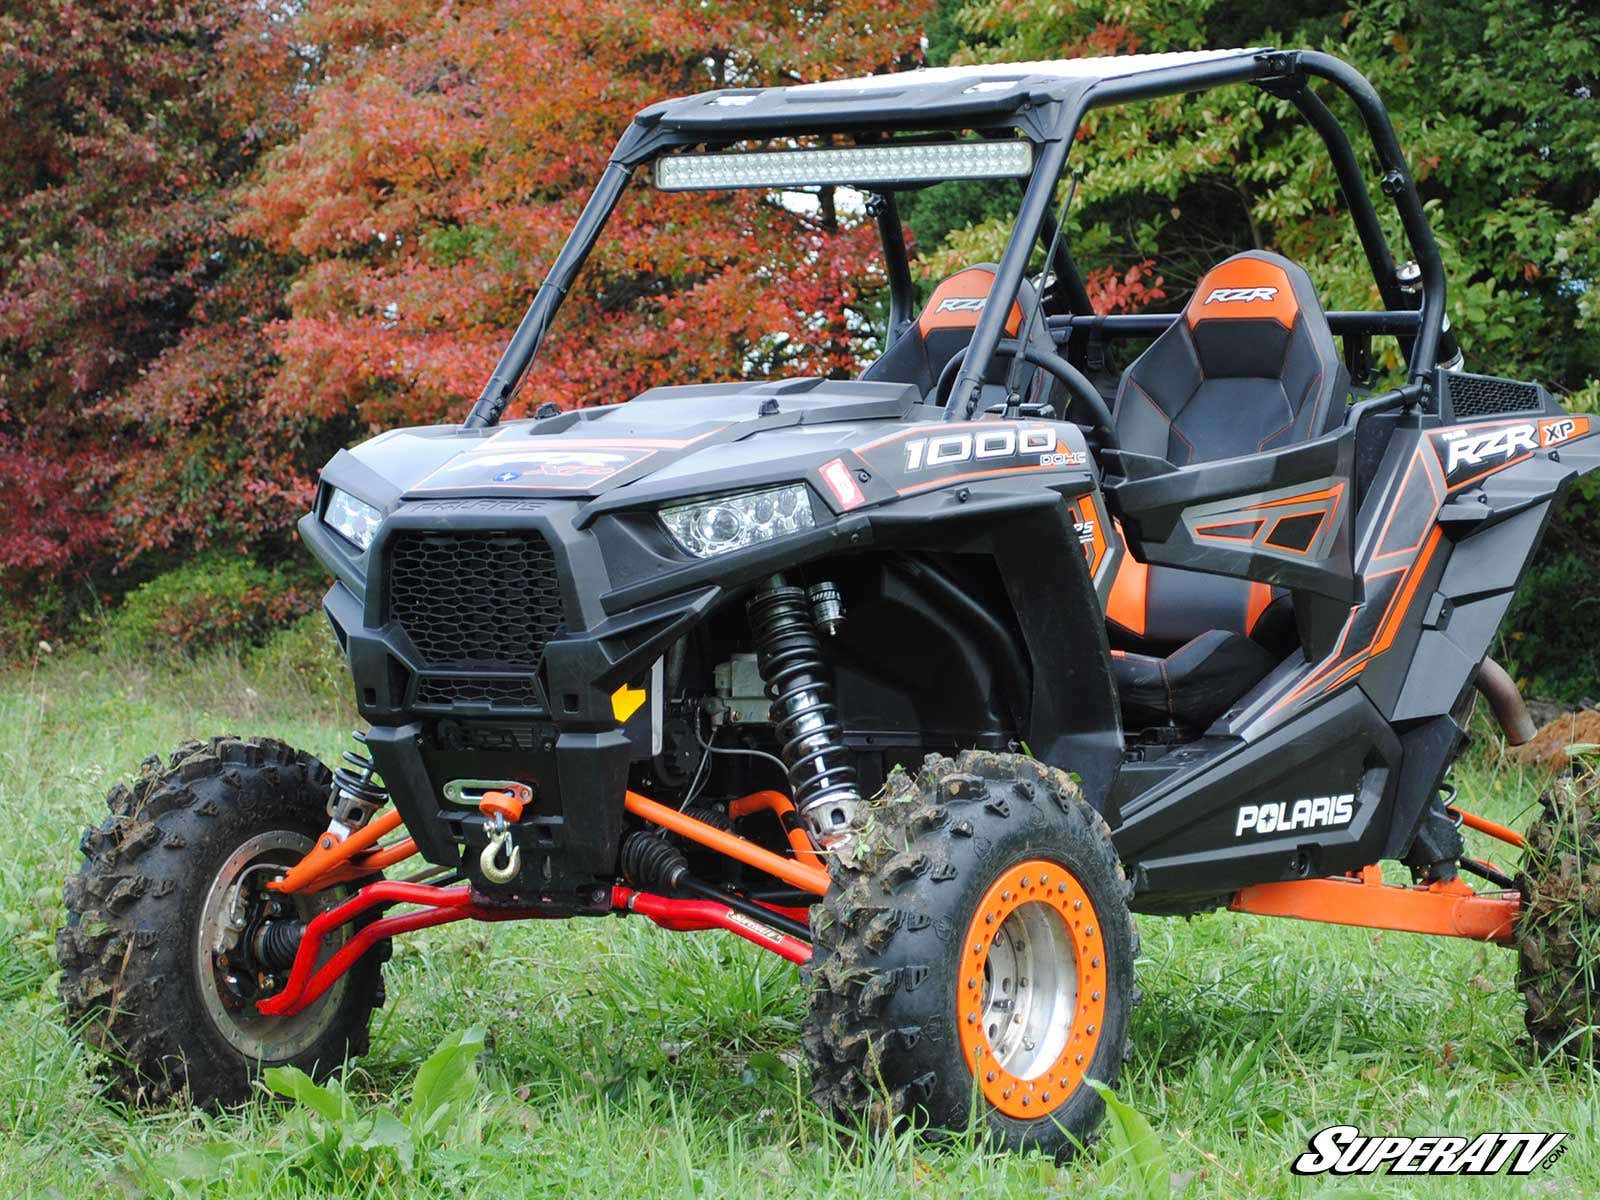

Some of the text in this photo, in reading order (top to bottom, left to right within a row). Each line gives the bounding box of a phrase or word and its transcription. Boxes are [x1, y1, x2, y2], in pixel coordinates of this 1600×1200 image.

[1204, 287, 1279, 305] RZR
[904, 428, 1057, 473] 1000
[1040, 452, 1087, 466] DOHC
[1446, 420, 1575, 474] RZR XP
[1235, 794, 1355, 837] POLARIS
